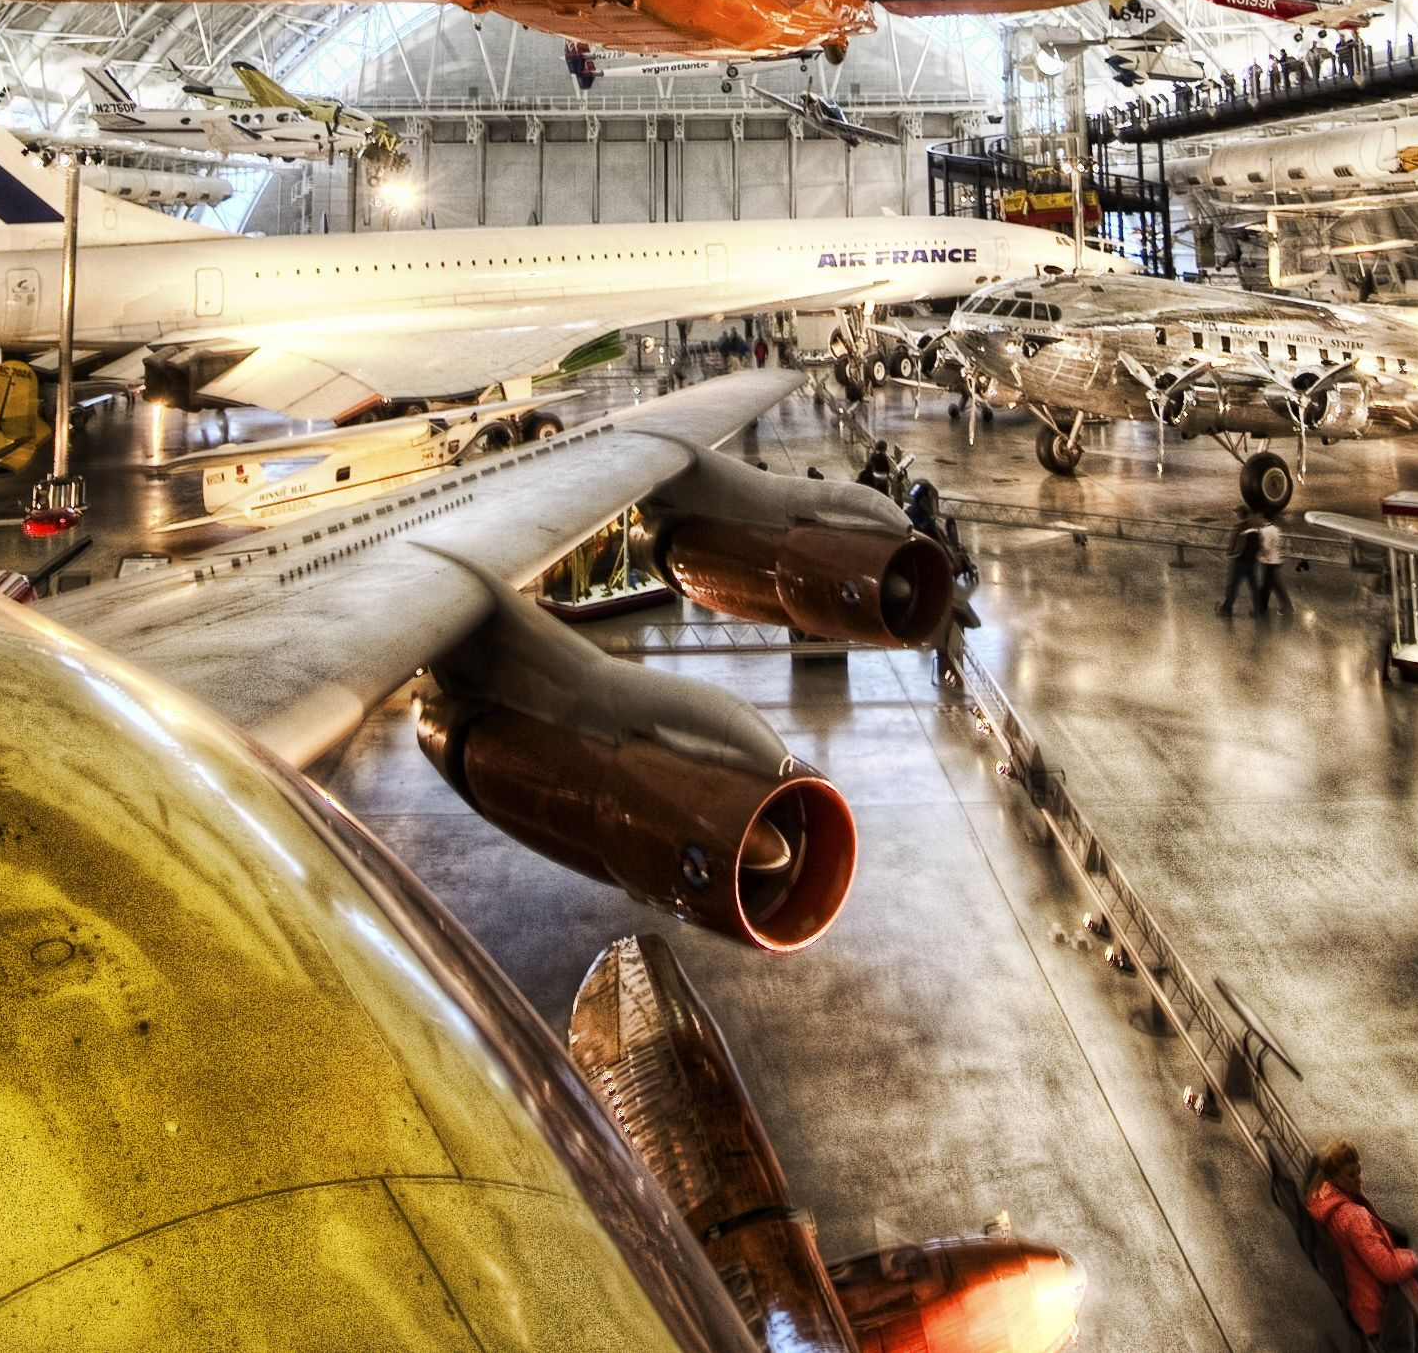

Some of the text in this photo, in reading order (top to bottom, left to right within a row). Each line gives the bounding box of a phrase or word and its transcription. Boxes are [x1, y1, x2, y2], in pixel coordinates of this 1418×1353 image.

[642, 62, 710, 74] virgin atlantic
[817, 248, 977, 268] AIR FRANCE
[1331, 339, 1364, 350] SYSTEM
